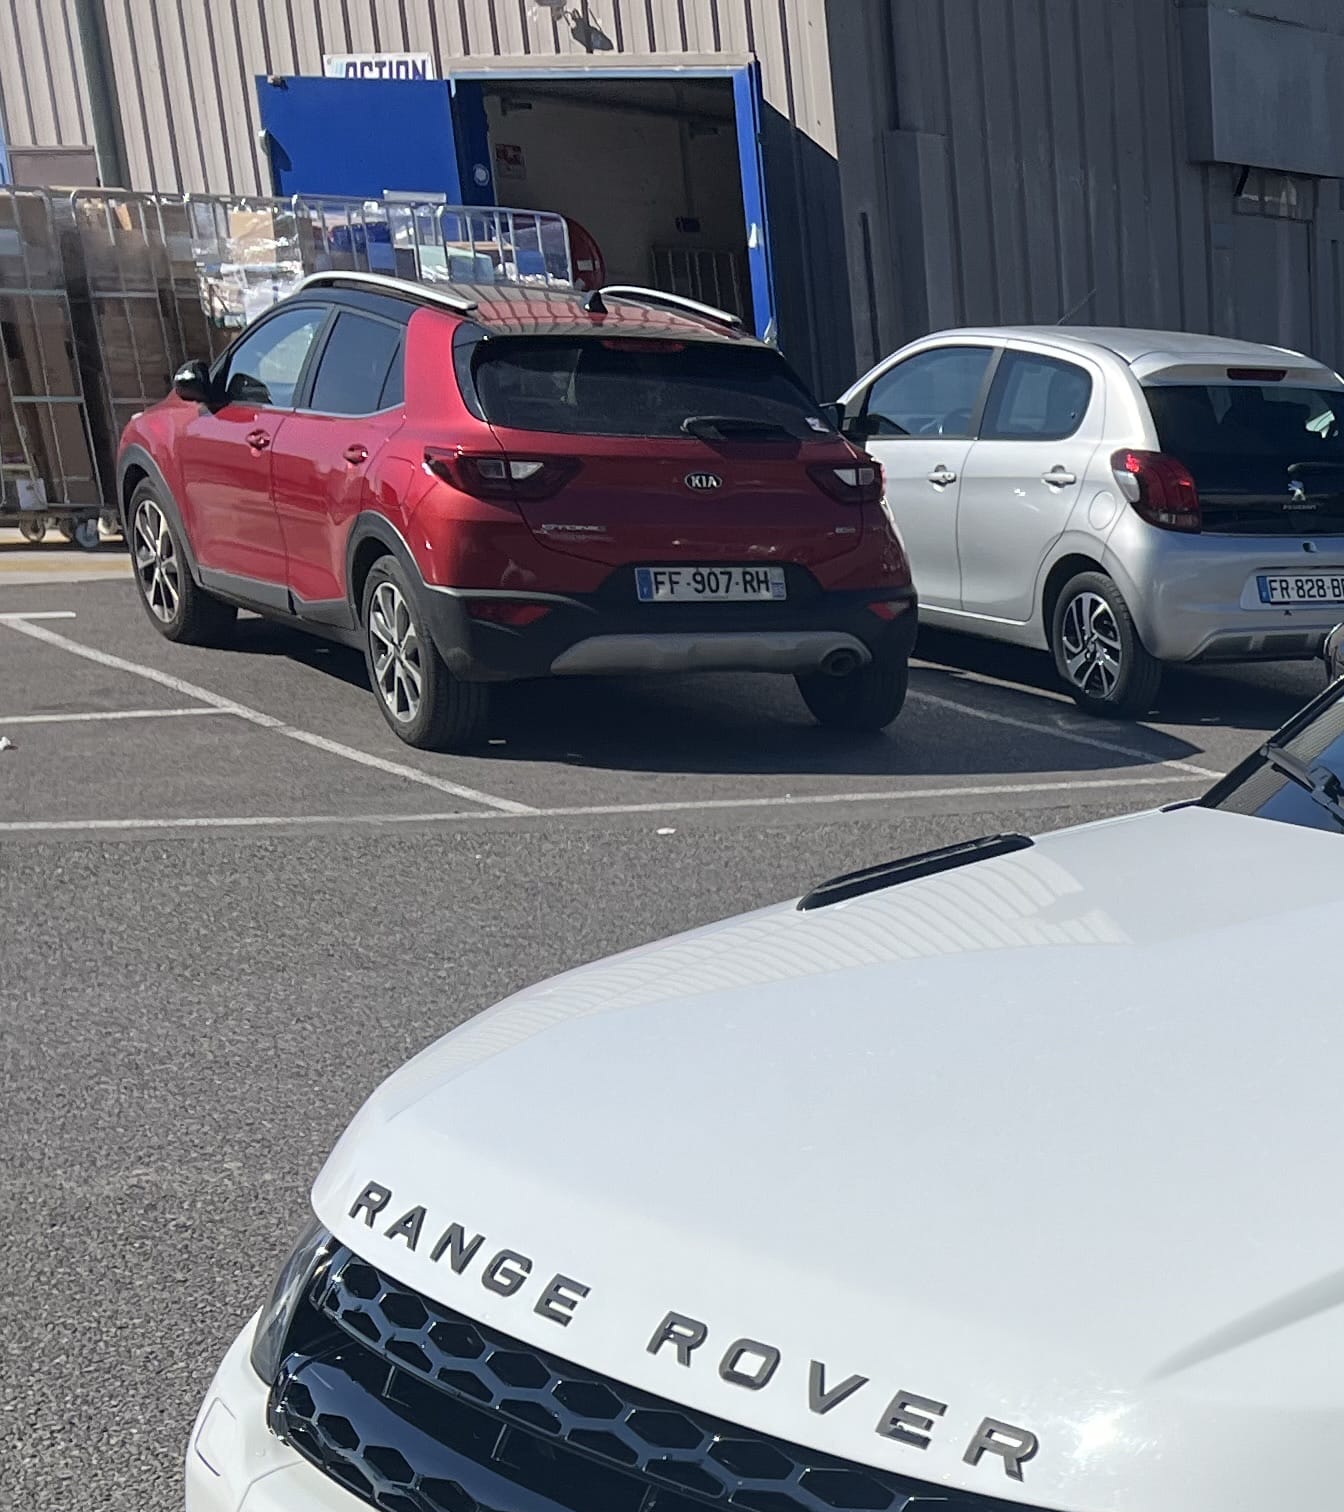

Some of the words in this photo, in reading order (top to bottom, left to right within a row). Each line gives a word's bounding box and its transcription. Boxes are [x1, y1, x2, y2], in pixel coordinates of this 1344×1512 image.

[345, 60, 426, 79] ACTION
[691, 475, 718, 488] KIA
[653, 570, 770, 594] FF-907-RH
[349, 1180, 592, 1328] RANGE
[645, 1310, 1039, 1484] ROVER
